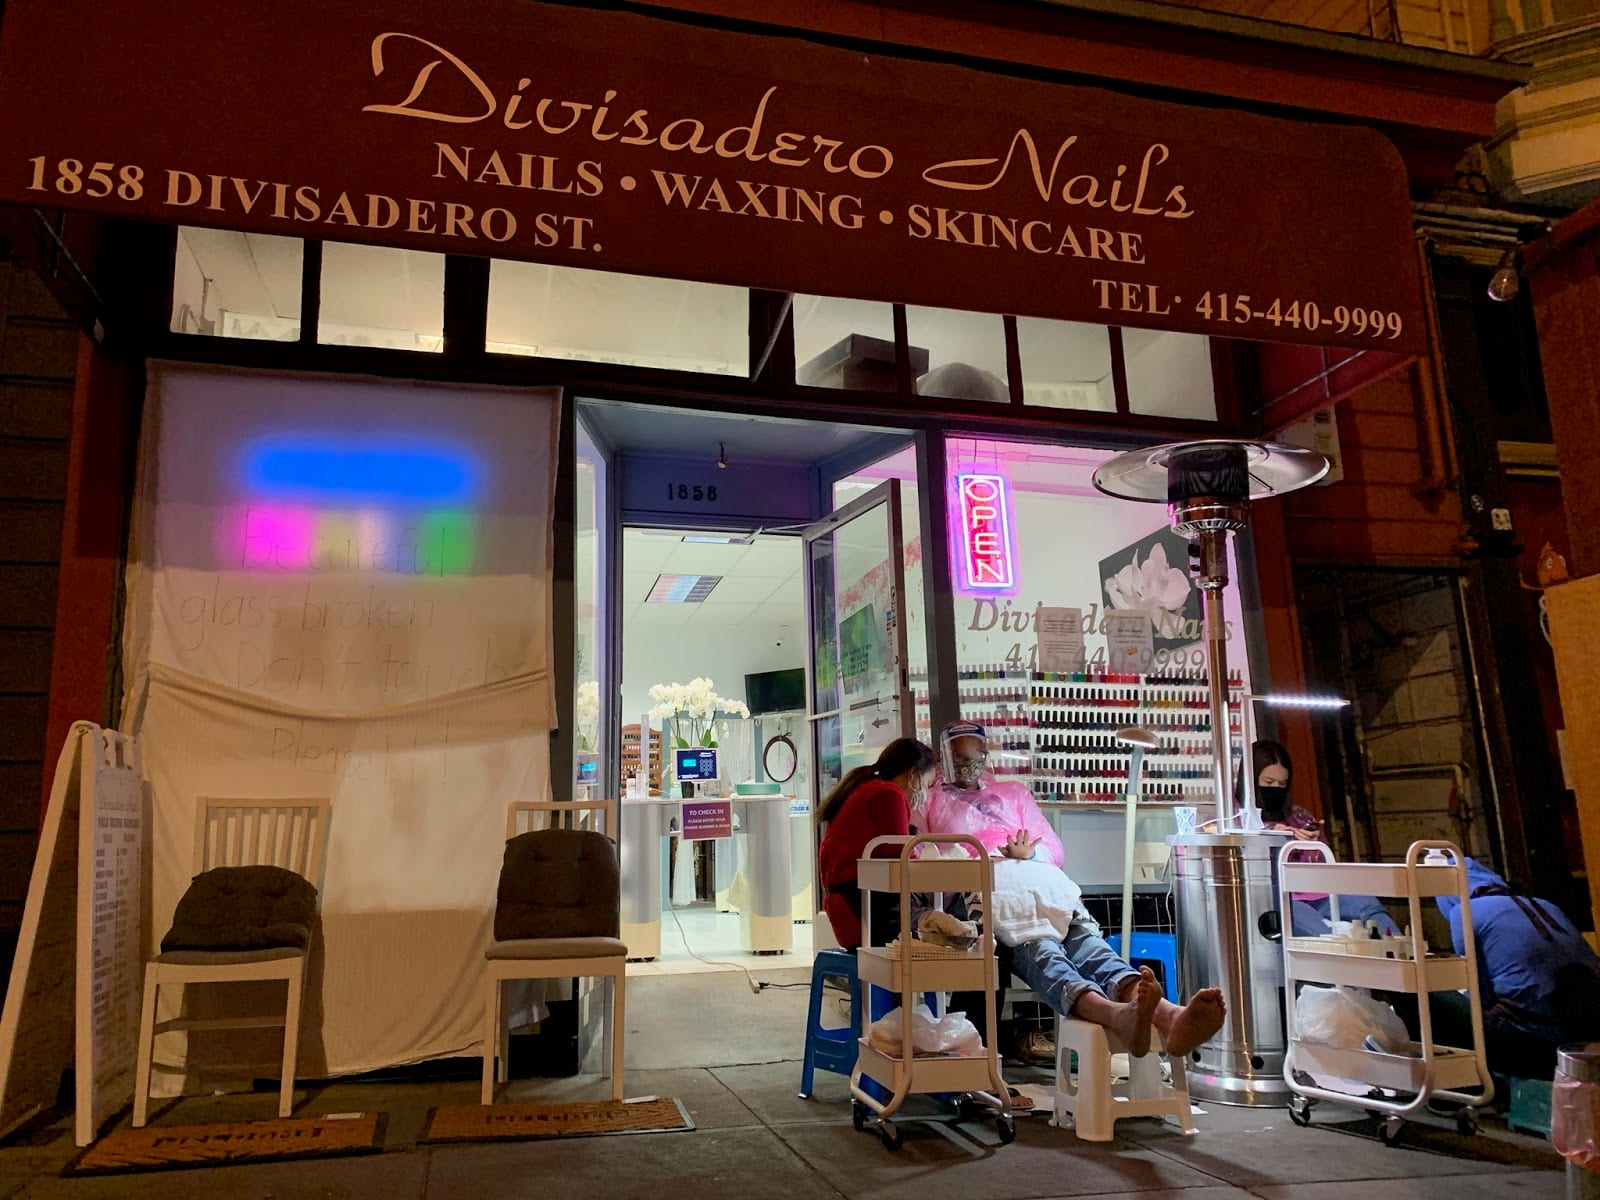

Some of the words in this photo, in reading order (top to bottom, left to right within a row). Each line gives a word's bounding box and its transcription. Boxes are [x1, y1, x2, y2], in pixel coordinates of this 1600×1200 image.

[362, 32, 894, 179] Divisadero
[923, 128, 1195, 219] Nails
[26, 156, 145, 201] 1858
[163, 169, 518, 243] DIVISADERO
[534, 213, 603, 252] ST.
[432, 142, 604, 197] NAILS
[651, 169, 866, 229] WAXING
[907, 203, 1146, 265] SKINCARE
[1196, 290, 1402, 340] 415-440-9999
[668, 483, 717, 501] 1858
[965, 479, 1005, 582] OPEN
[180, 576, 282, 651] glass
[300, 580, 436, 631] broken
